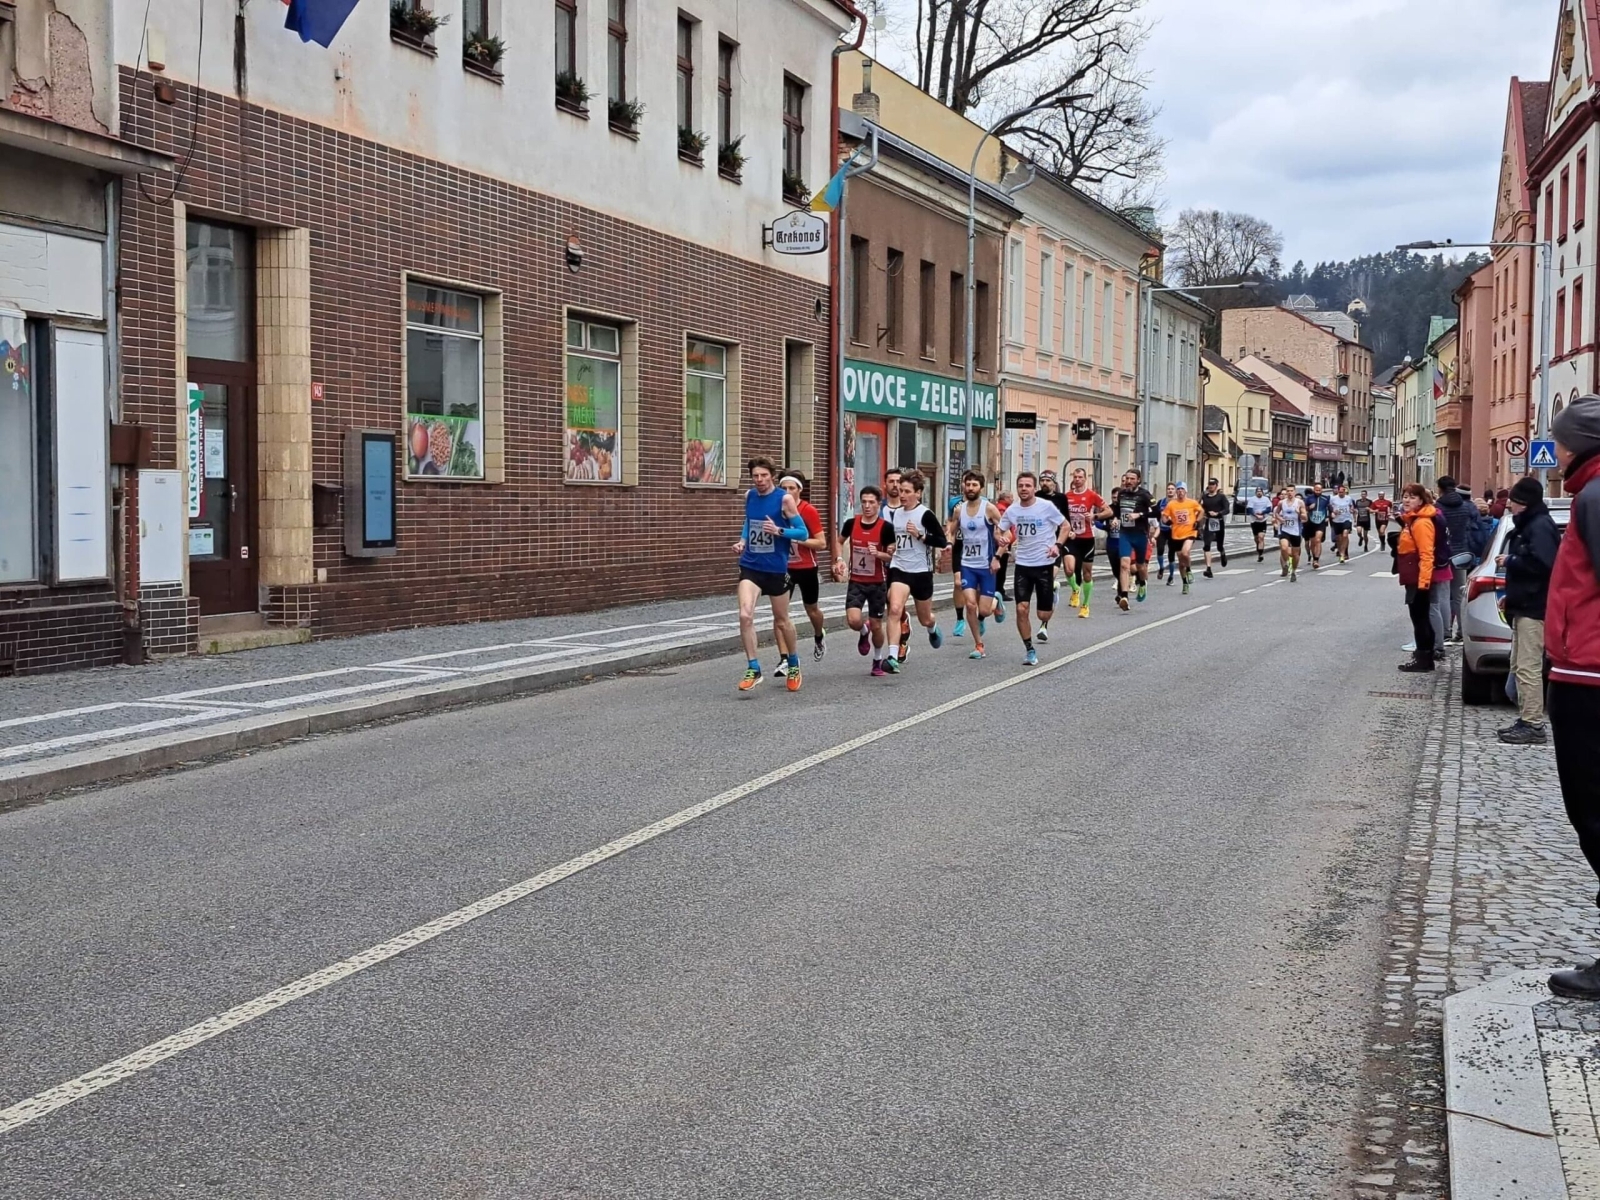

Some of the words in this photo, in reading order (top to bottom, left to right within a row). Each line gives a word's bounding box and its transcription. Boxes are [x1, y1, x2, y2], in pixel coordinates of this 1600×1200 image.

[843, 367, 907, 409] OVOCE
[189, 389, 205, 511] KRÁLOVSTVÍ
[1177, 514, 1187, 522] 53
[1017, 523, 1037, 536] 278
[750, 530, 773, 546] 243
[896, 534, 913, 549] 271
[964, 544, 981, 557] 247
[859, 556, 866, 569] 4
